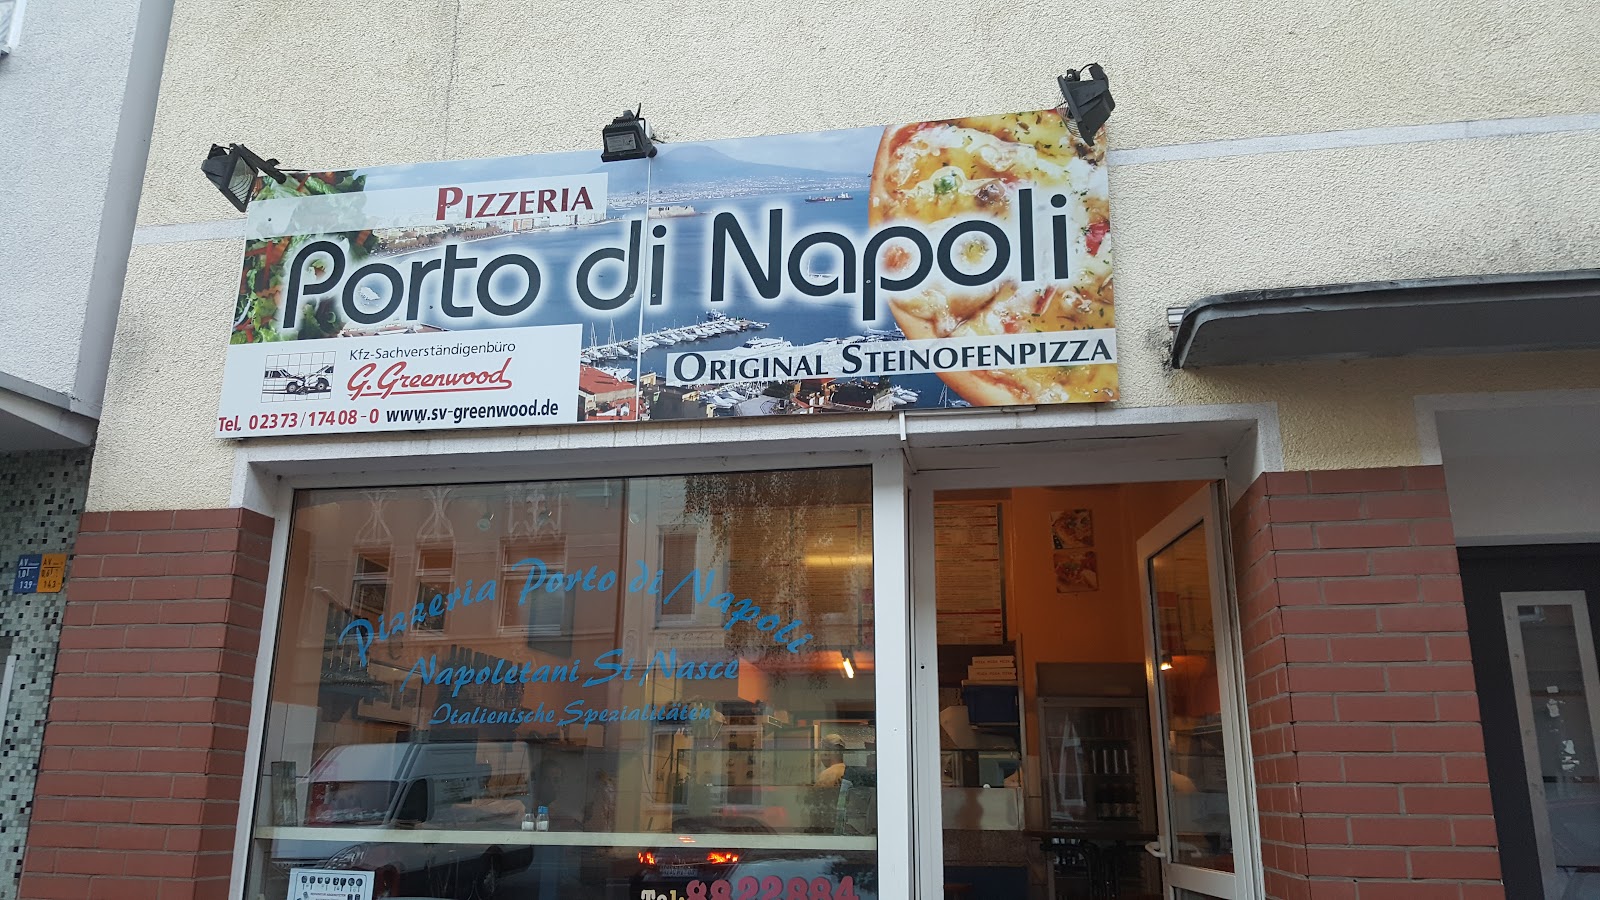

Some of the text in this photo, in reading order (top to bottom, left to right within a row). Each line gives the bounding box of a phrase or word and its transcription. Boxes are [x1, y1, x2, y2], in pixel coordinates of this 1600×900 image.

[436, 186, 594, 221] PIZZERIA
[282, 187, 1070, 329] Porto di Napoli
[349, 342, 516, 361] Kfz-Sachverständigenbüro
[673, 339, 1113, 383] ORIGINAL STEINOFENPIZZA
[347, 357, 513, 401] G. Greenwood
[386, 399, 559, 424] www.sv-greenwood.de
[338, 557, 814, 668] Pizzeria Porto di Napoli
[399, 647, 739, 698] Napoletani Si Nasce
[427, 699, 711, 731] Italienische Spezialitäten
